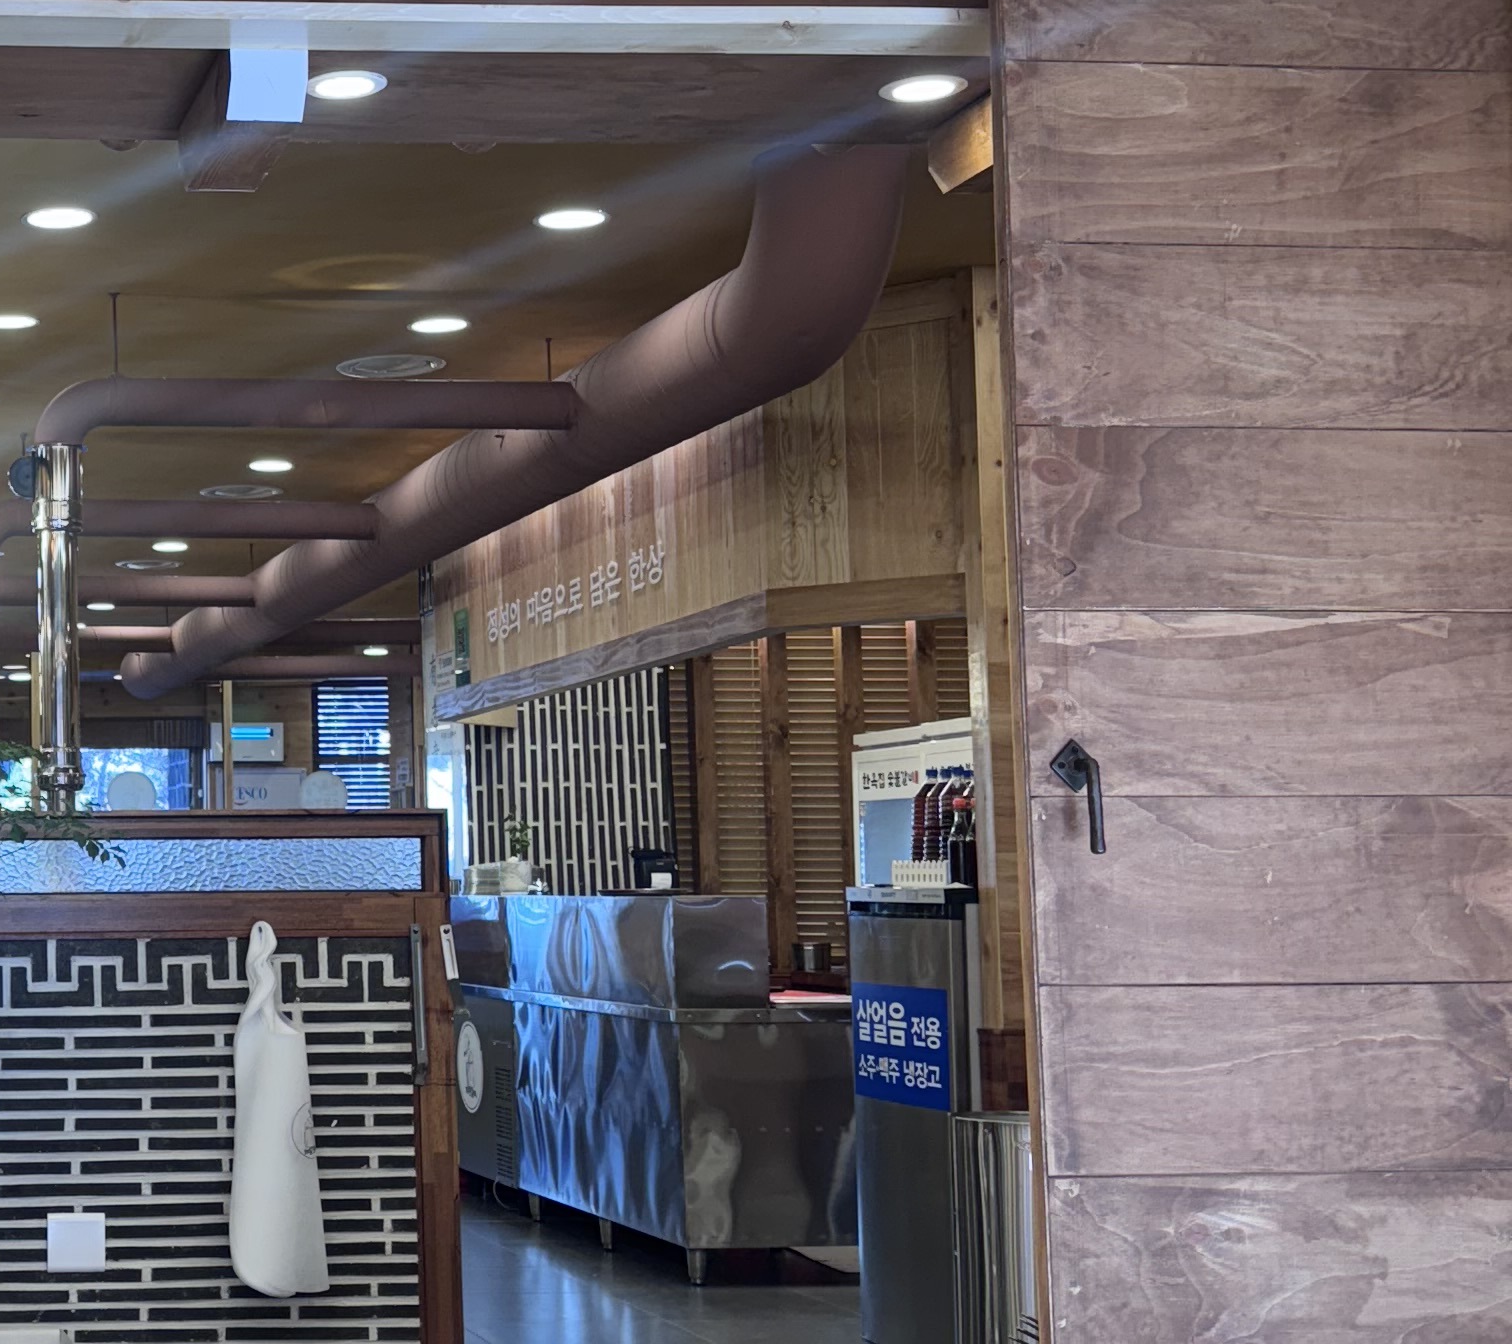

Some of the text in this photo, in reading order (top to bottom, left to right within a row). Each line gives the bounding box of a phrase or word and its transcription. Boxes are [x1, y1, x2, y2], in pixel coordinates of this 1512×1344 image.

[487, 598, 521, 643] 정성의
[526, 577, 584, 626] 마음으로
[590, 560, 622, 607] 담은
[628, 540, 665, 593] 한상
[856, 998, 942, 1050] 살얼음 전용
[903, 1059, 943, 1089] 냉장고
